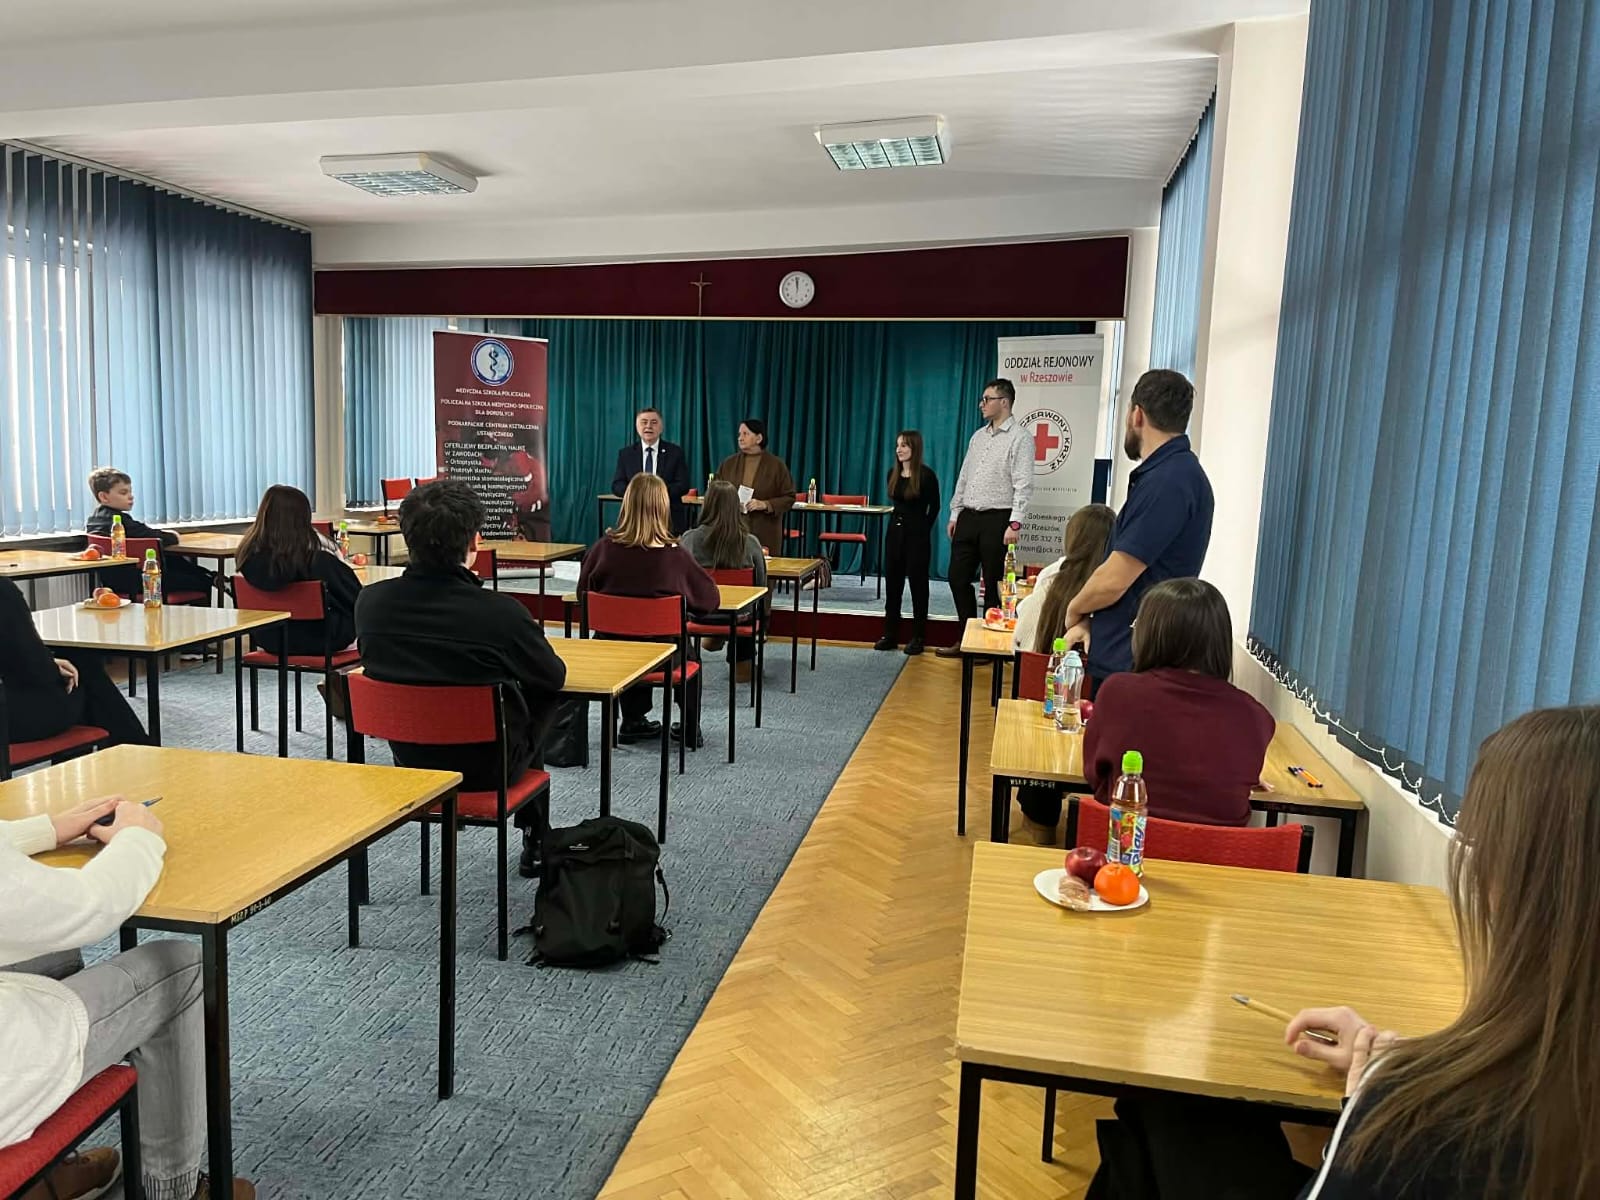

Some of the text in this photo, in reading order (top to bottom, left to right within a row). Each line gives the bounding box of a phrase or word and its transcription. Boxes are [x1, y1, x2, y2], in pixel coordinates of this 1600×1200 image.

[1004, 355, 1095, 369] ODDZIAŁ REJONOWY
[1020, 371, 1073, 383] w Rzeszowie
[485, 421, 508, 429] CENTRUM
[1020, 411, 1069, 433] CZERWONY
[444, 442, 477, 450] OFERUJEMY
